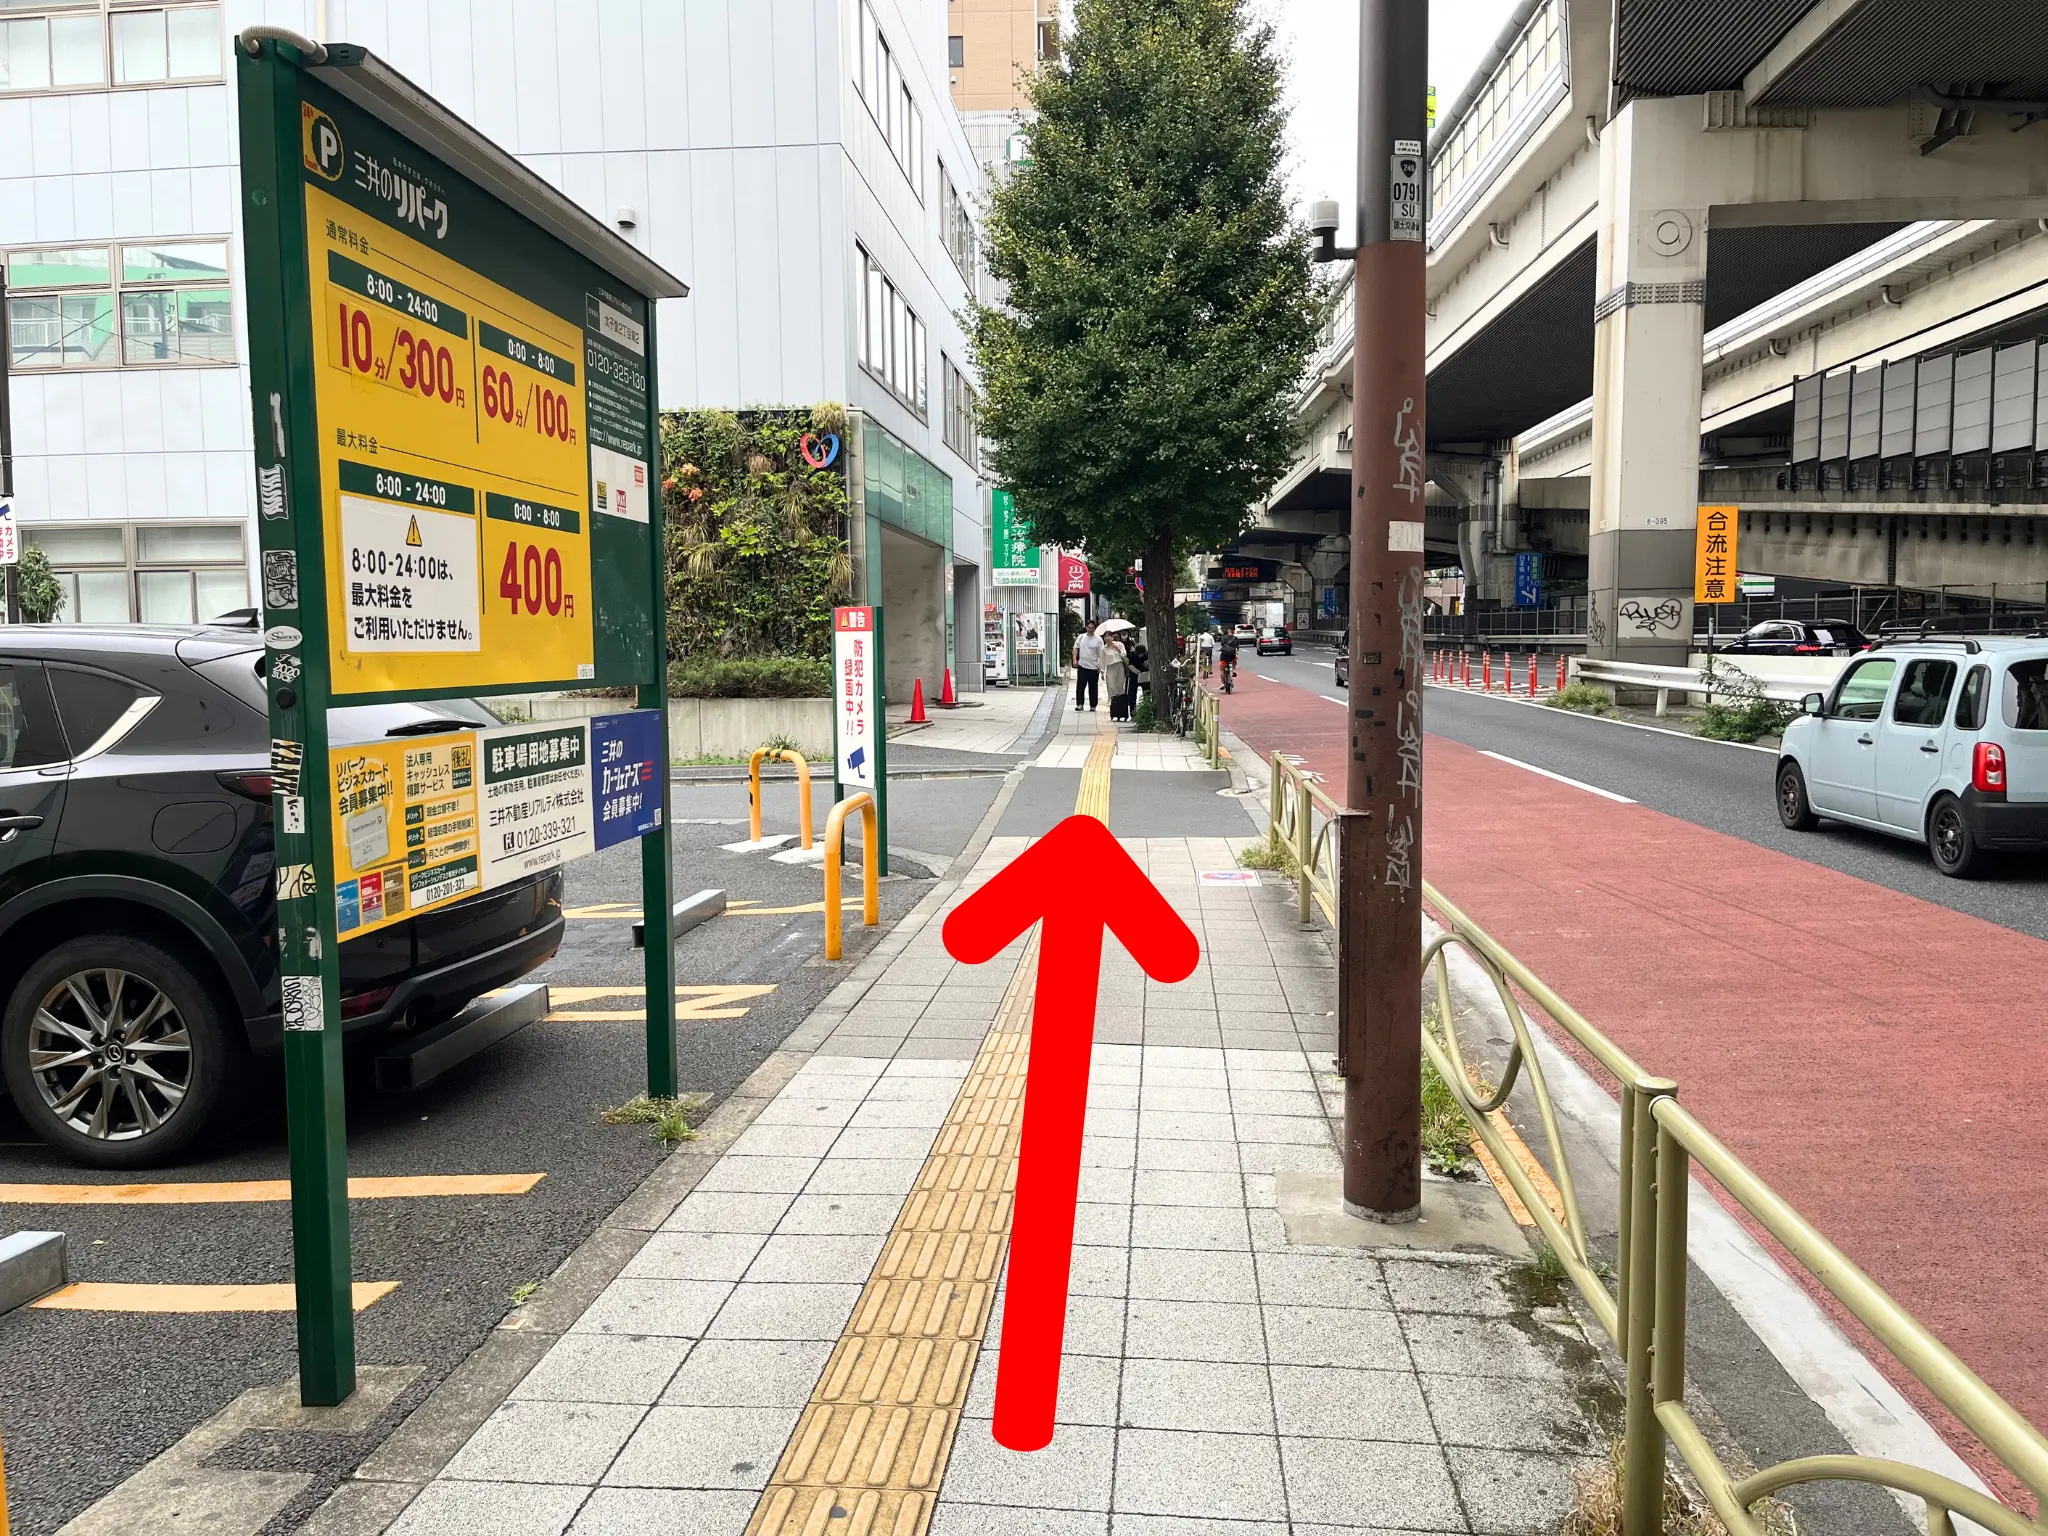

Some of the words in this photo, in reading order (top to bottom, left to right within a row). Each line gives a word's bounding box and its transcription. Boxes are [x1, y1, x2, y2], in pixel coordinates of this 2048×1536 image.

[354, 151, 448, 239] 三井のリパーク
[1393, 183, 1420, 202] 0791
[1401, 204, 1415, 217] SU
[326, 218, 369, 256] 通常料金
[367, 274, 393, 303] 8:00
[407, 292, 438, 323] 24:00
[508, 339, 526, 361] 0:00
[538, 352, 555, 374] 8:00
[337, 428, 378, 455] 最大料金
[376, 473, 402, 497] 8:00
[415, 481, 446, 506] 24:00
[514, 502, 532, 521] 0:00
[543, 509, 560, 527] 8:00
[5, 526, 14, 559] カメラ
[1704, 511, 1728, 599] 合流注意
[500, 541, 574, 618] 400円
[351, 582, 413, 609] 最大料金を
[354, 616, 473, 641] ご利用いただけません。
[849, 611, 866, 628] 警告
[272, 661, 300, 679] 2020
[854, 639, 864, 736] 防犯カメラ
[406, 751, 432, 768] 法人専用
[491, 734, 580, 774] 駐車場用地募集中
[601, 740, 624, 763] 三井の
[336, 756, 366, 777] リパーク
[337, 763, 389, 794] ビジネスカード
[406, 764, 450, 782] キャッシュレス
[407, 779, 445, 797] 精算サービス
[489, 788, 585, 828] 三井不動産リアルティ株式会社
[602, 792, 643, 822] 会員募集中!
[516, 815, 576, 849] 0120-339-321
[523, 848, 562, 870] www.repark.jp
[426, 878, 465, 901] 0120-201-321
